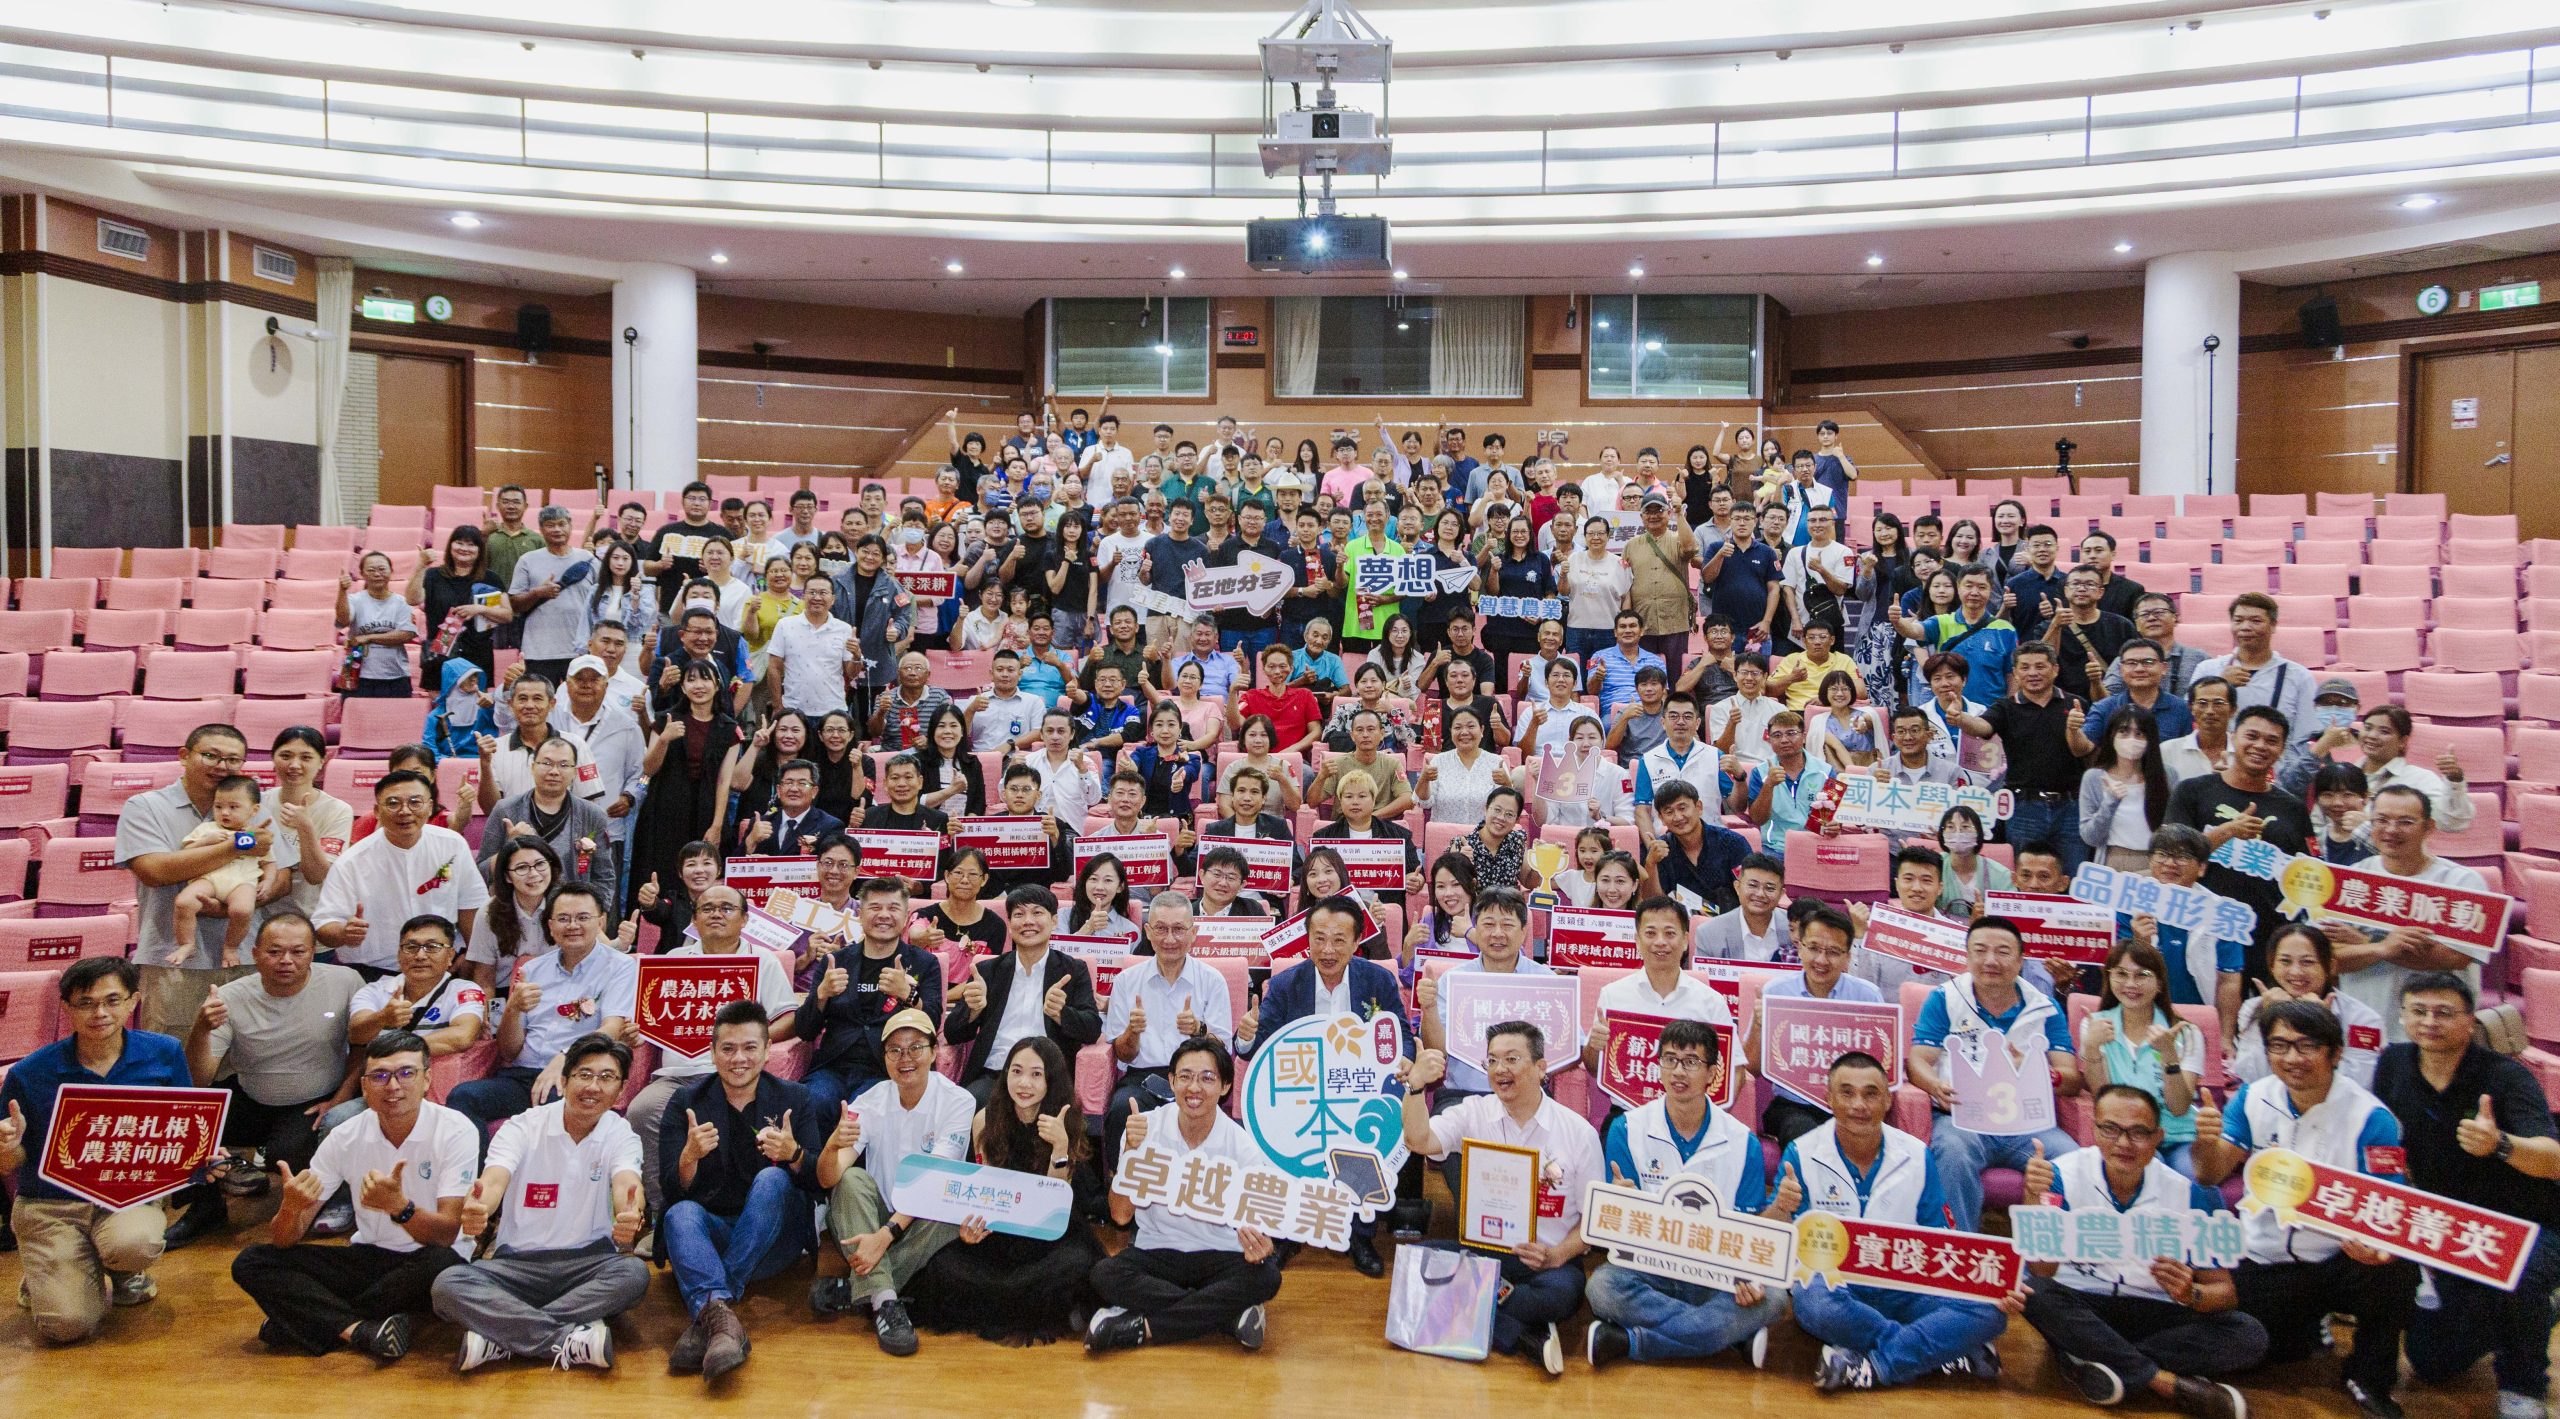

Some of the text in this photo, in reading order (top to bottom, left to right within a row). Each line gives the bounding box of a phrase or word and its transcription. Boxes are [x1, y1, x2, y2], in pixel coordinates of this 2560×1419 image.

[434, 300, 445, 315] 3
[2427, 292, 2439, 308] 6
[1192, 571, 1282, 599] 在地分享
[1359, 557, 1433, 593] 夢想
[1479, 596, 1562, 618] 智慧農業
[1965, 743, 2003, 769] 第3
[1542, 772, 1588, 797] 第3屆
[1124, 864, 1161, 874] 程工程師
[2074, 865, 2250, 941] 品牌形象
[2336, 878, 2487, 934] 農業脈動
[659, 979, 735, 998] 農為國本
[1473, 999, 1552, 1020] 國本學堂
[1377, 1023, 1394, 1059] 嘉義
[1789, 1024, 1873, 1049] 國本同行
[1327, 1067, 1377, 1094] 學堂
[86, 1114, 190, 1139] 青農扎根
[78, 1140, 185, 1164] 農業向前
[99, 1169, 157, 1181] 國本學堂
[944, 1179, 1013, 1208] 國本學堂
[1119, 1147, 1349, 1243] 卓越農業
[1598, 1203, 1775, 1267] 農業知識殿堂
[2016, 1211, 2241, 1263] 職農精神
[2309, 1180, 2506, 1269] 卓越菁英
[1637, 1253, 1731, 1284] CHIAYI COUNTY
[1853, 1232, 2006, 1287] 實踐交流
